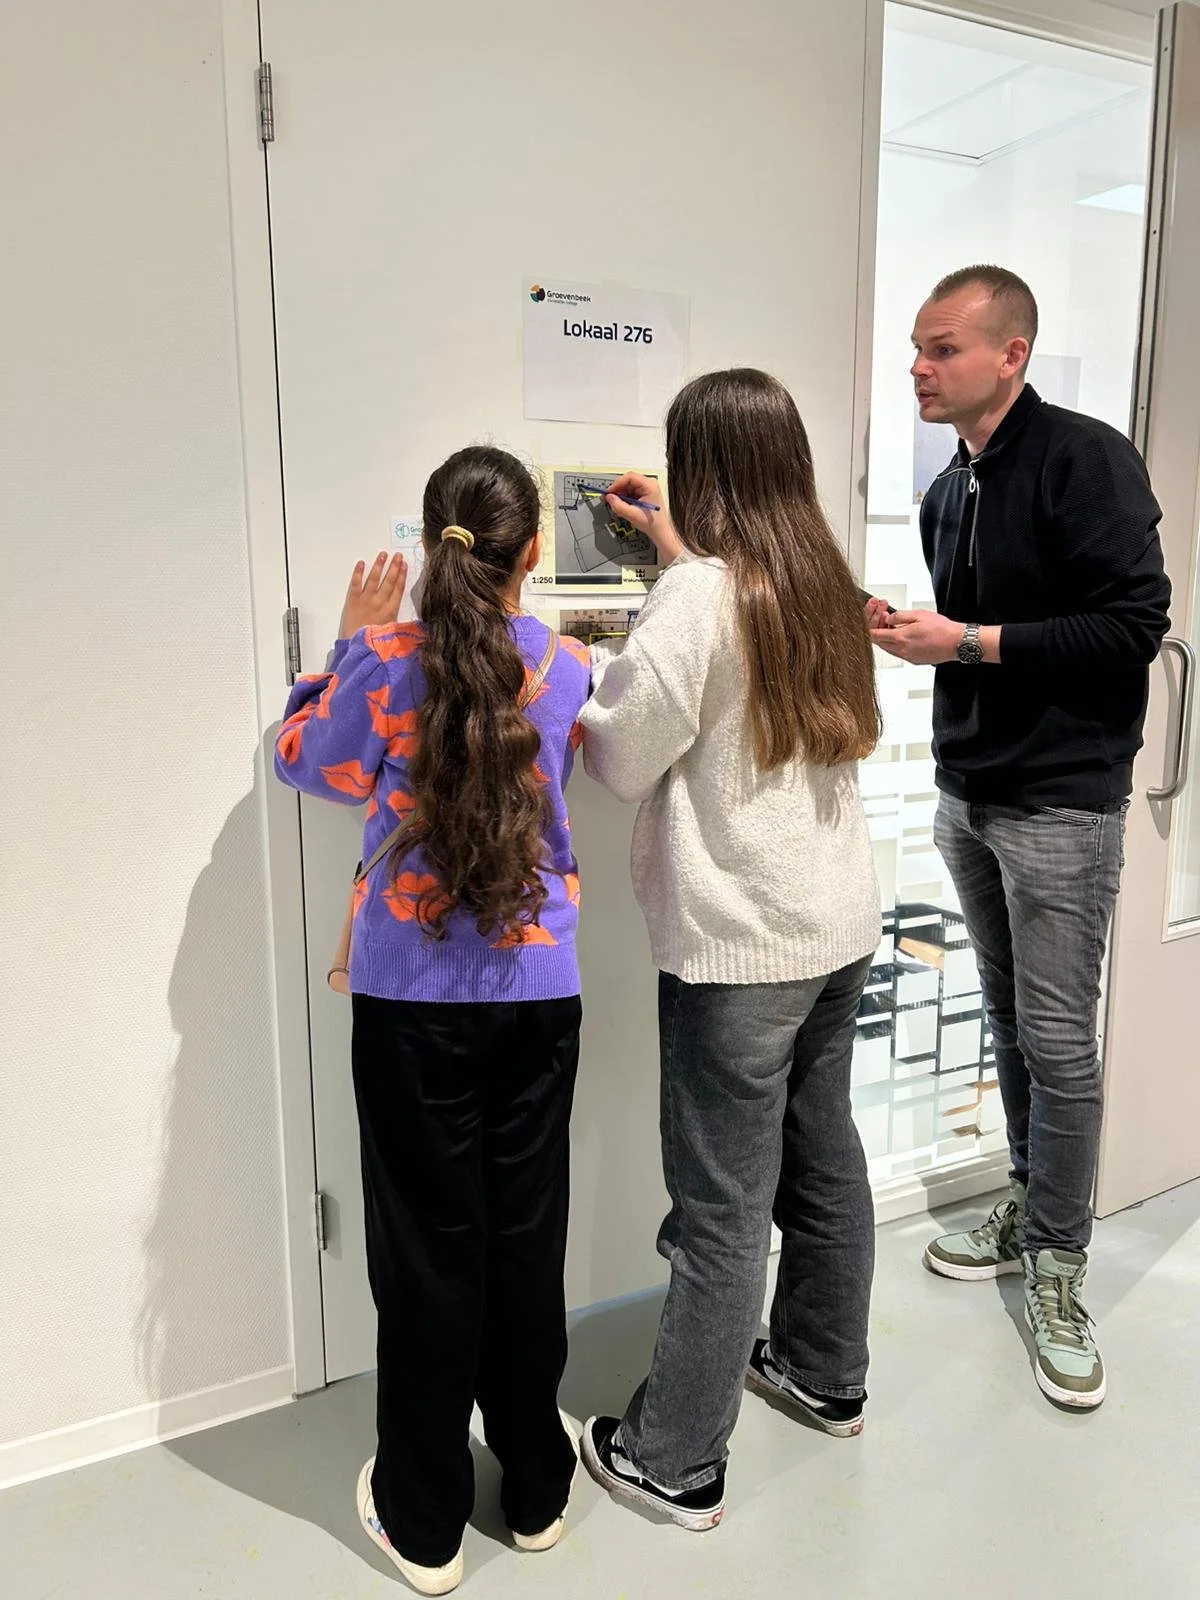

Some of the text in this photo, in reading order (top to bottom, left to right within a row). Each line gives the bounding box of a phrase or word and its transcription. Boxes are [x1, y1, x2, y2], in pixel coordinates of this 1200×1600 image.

[547, 290, 591, 302] Groevenbeek
[563, 319, 653, 344] Lokaal 276
[532, 576, 553, 584] 1:250
